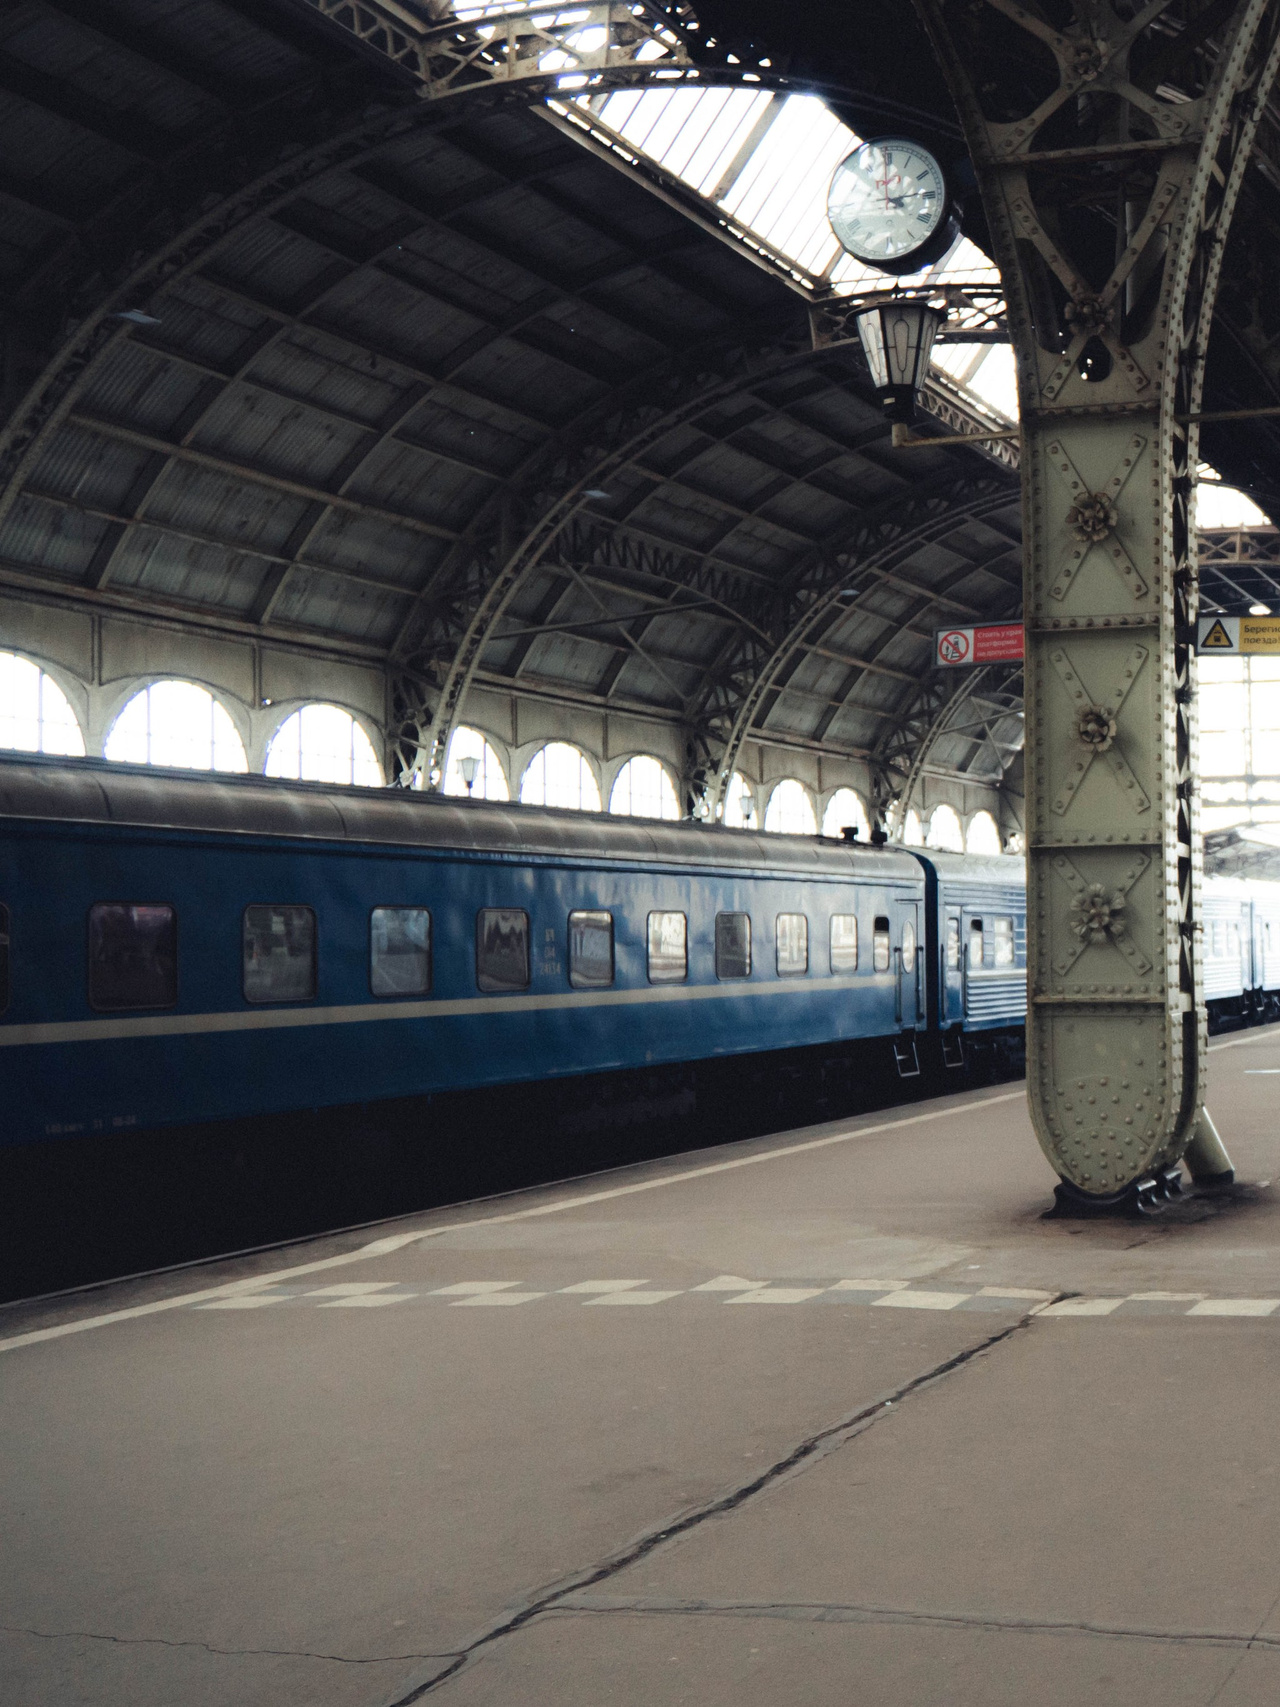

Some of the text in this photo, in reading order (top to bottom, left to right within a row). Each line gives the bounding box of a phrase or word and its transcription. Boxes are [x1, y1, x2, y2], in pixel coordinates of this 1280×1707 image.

[977, 640, 1017, 648] платформы
[1243, 636, 1280, 645] поезда!
[987, 648, 1023, 656] допускаетс
